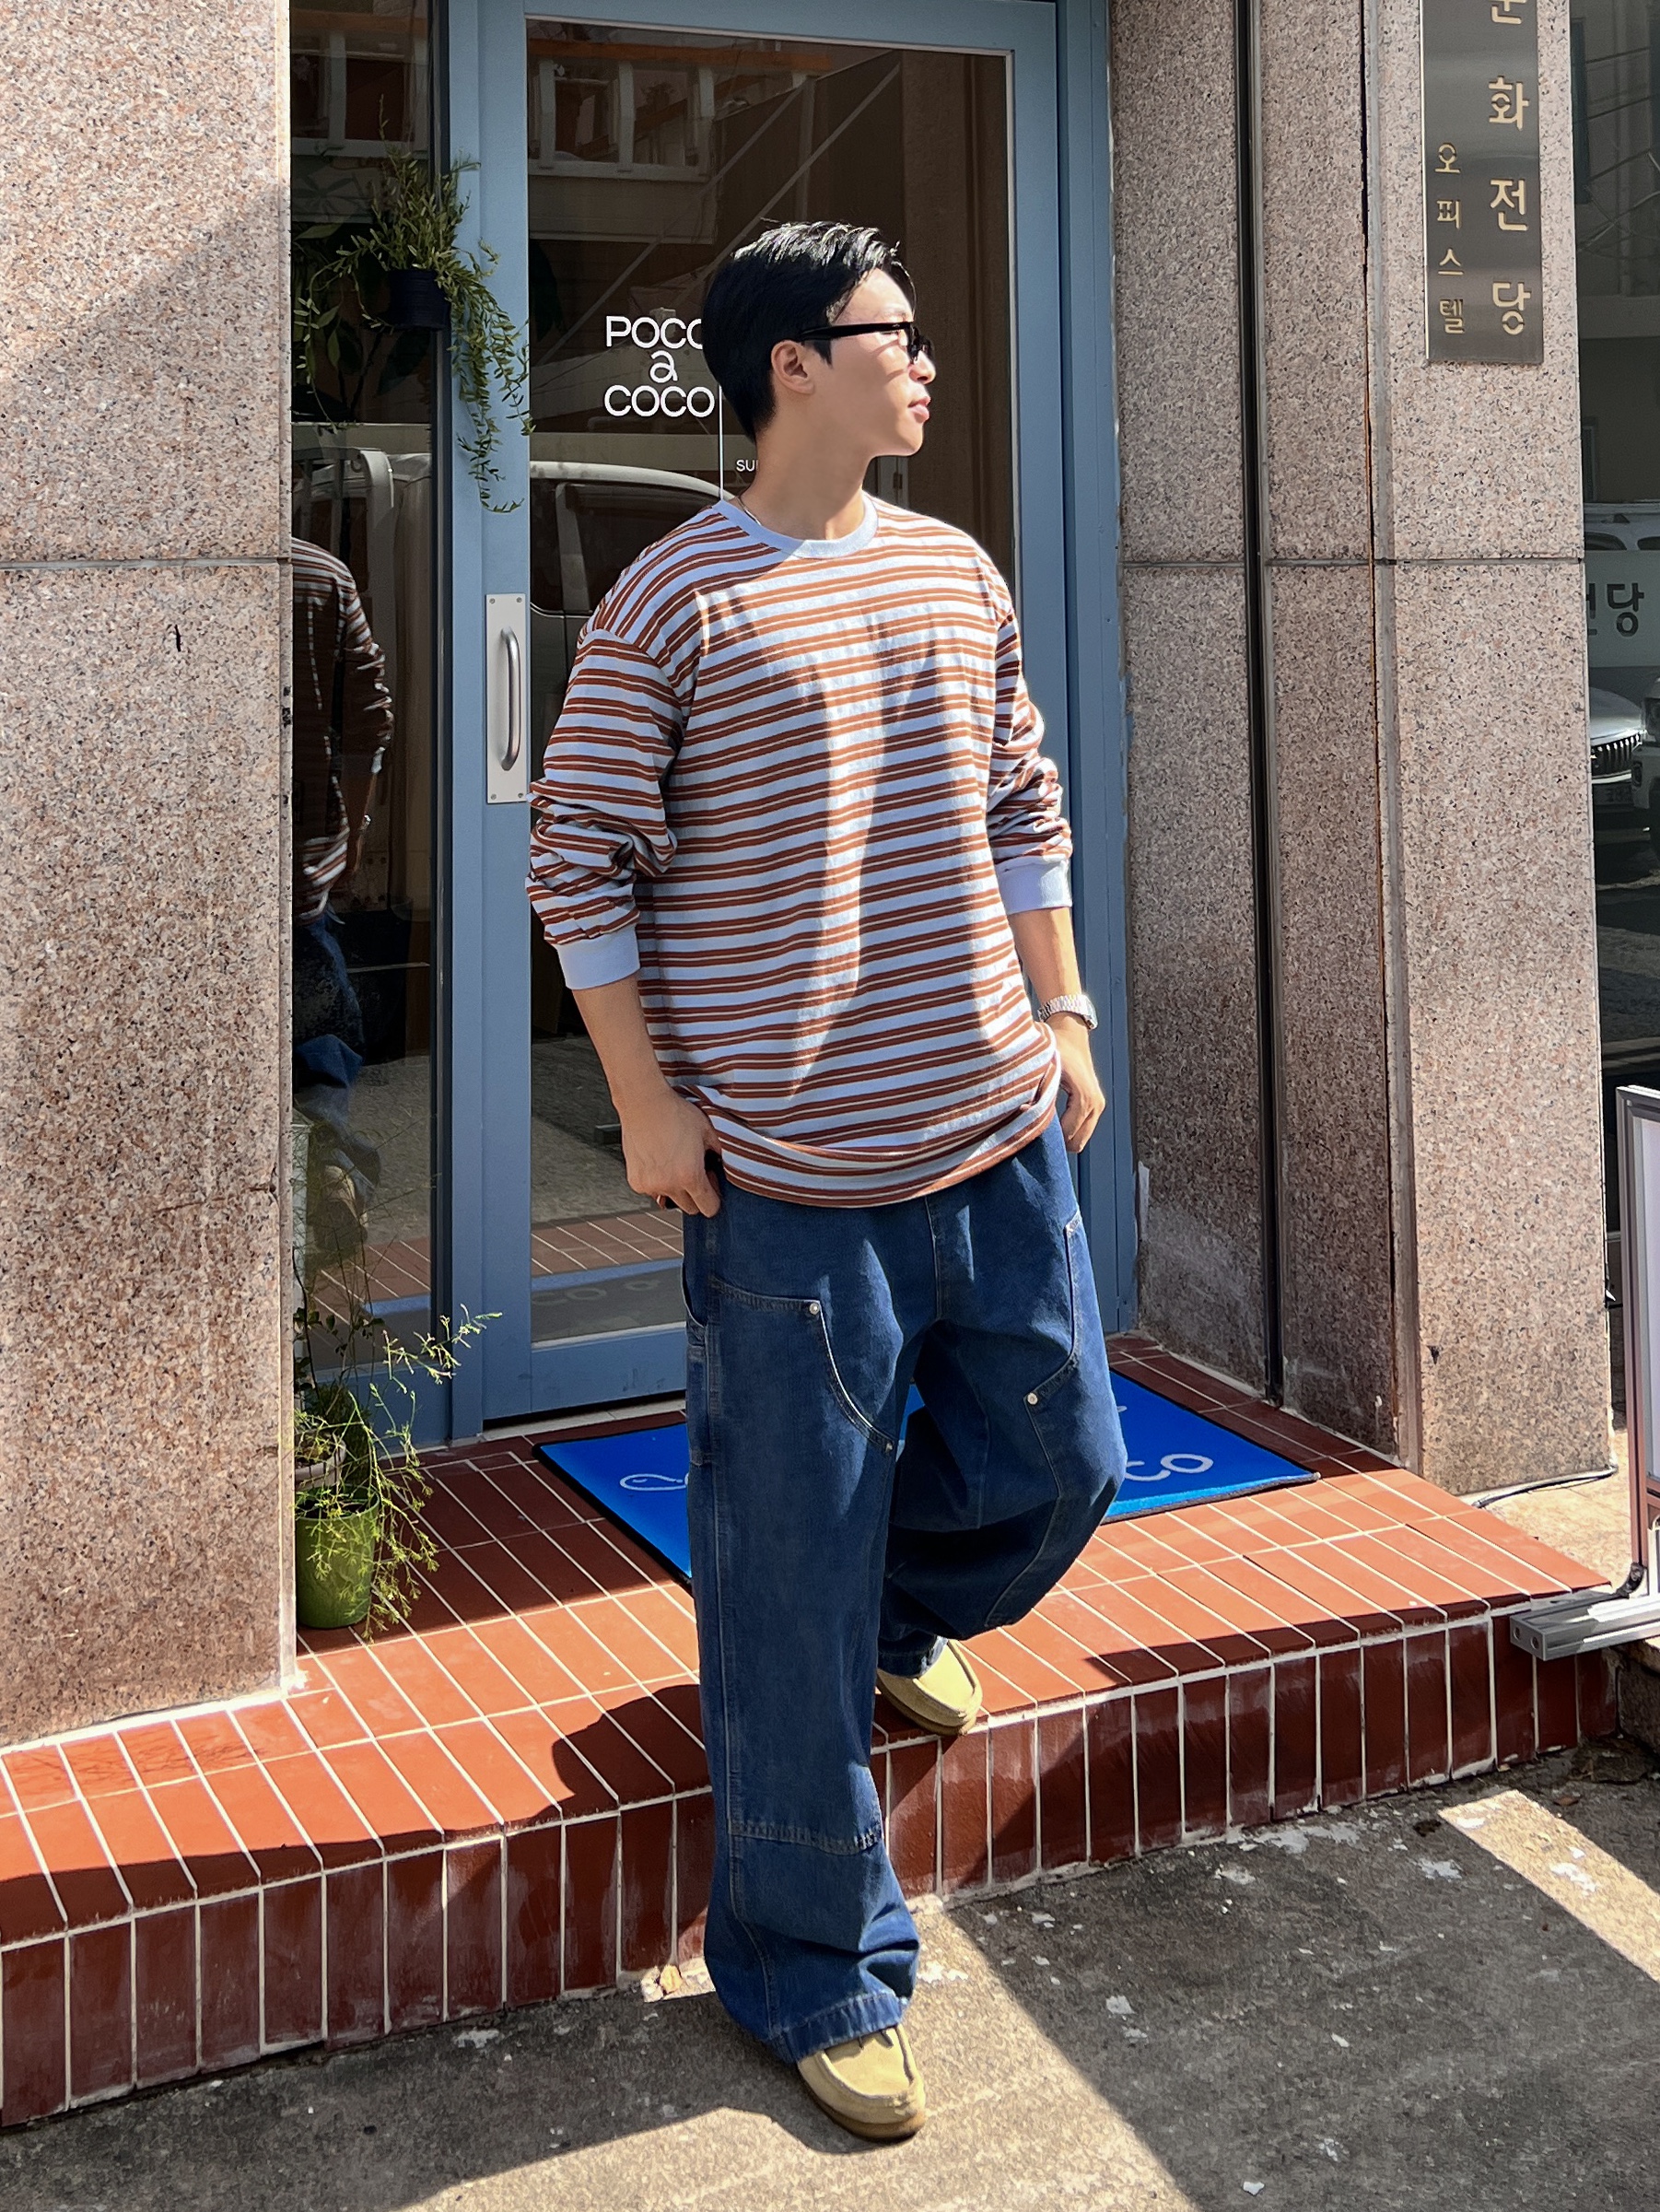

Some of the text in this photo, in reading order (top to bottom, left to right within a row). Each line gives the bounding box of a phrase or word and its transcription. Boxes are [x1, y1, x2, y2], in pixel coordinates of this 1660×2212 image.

[1434, 142, 1466, 334] 오피스텔
[649, 350, 678, 383] a
[604, 384, 715, 417] COCO
[736, 459, 758, 472] SU
